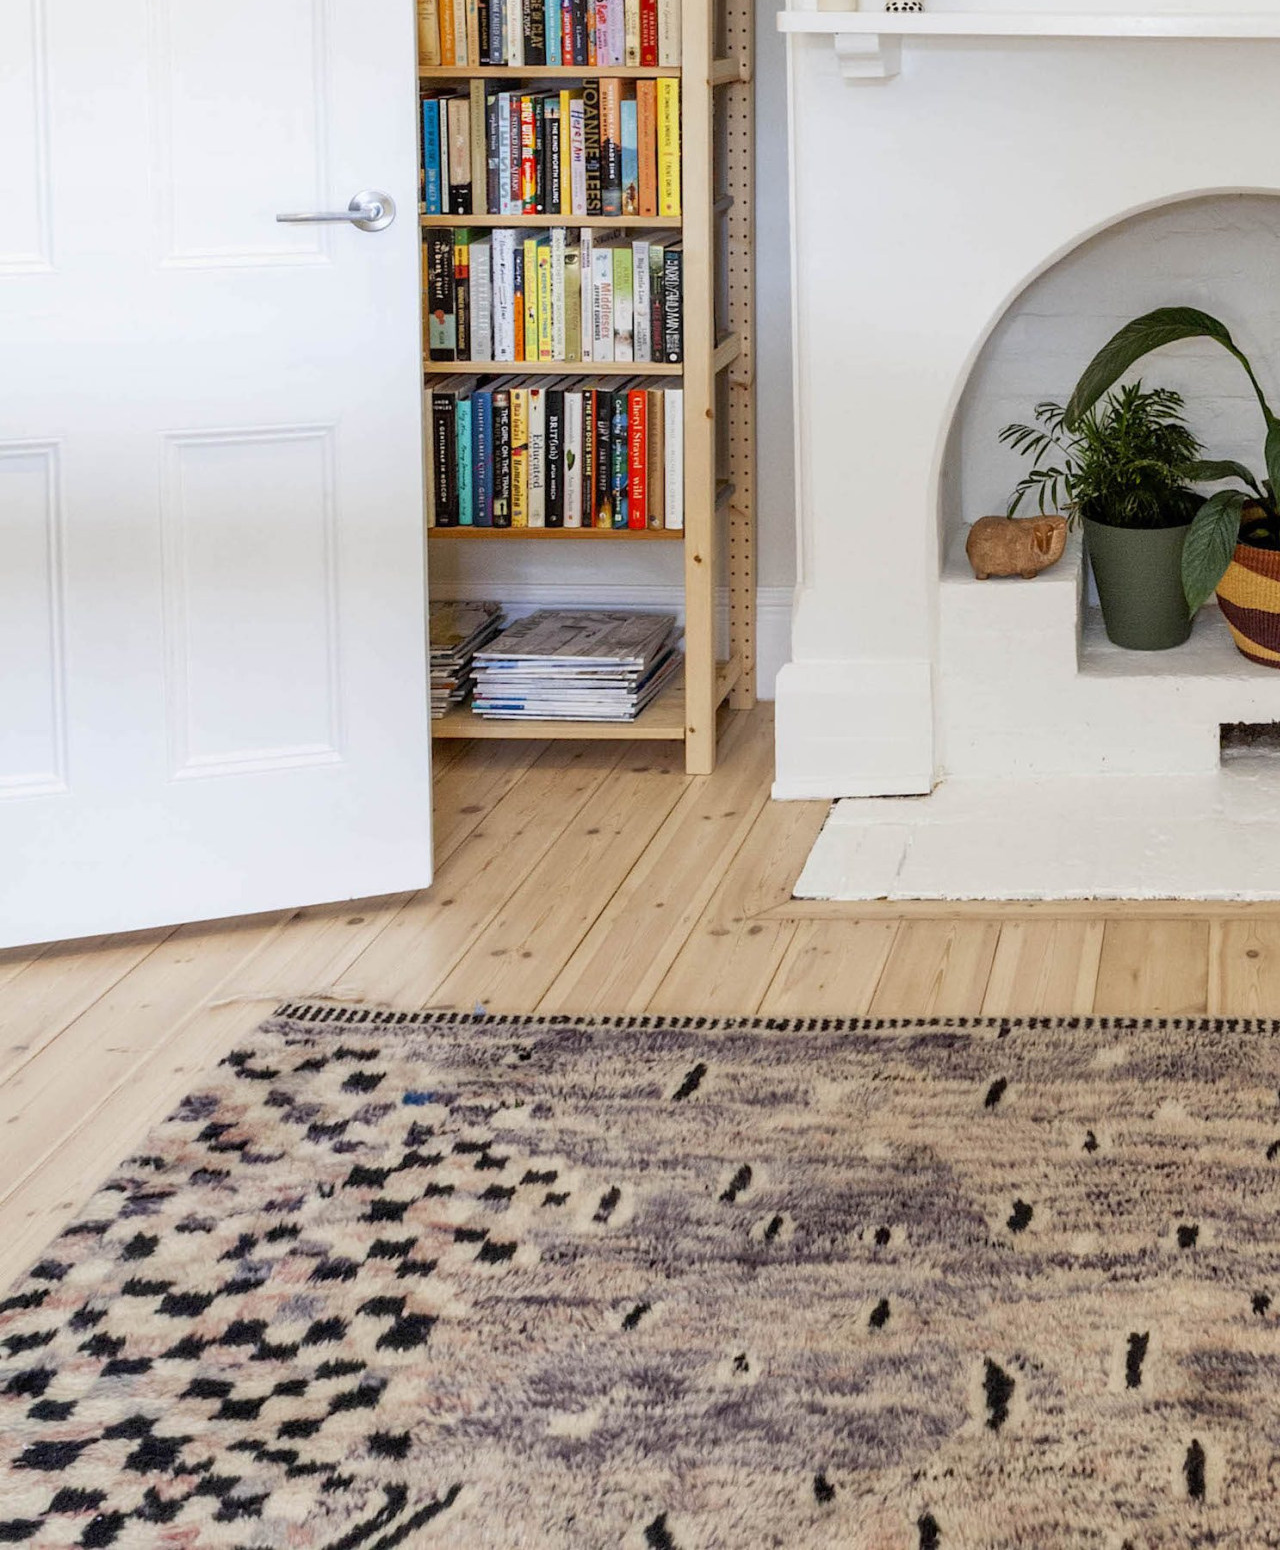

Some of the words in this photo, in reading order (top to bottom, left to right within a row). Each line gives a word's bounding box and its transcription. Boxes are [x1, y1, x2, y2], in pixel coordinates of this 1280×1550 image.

[531, 23, 543, 49] CLAY
[521, 101, 533, 123] STAY
[571, 110, 584, 137] Here
[582, 77, 600, 158] JOANNE
[522, 124, 533, 145] WITH
[586, 172, 600, 210] LEES
[593, 284, 601, 308] JEFFREY
[601, 282, 611, 339] Middlesex
[630, 397, 642, 429] Cheryl
[501, 426, 509, 444] GIRL
[597, 420, 609, 441] DRY
[502, 446, 509, 457] ON
[532, 434, 543, 489] Educated
[630, 432, 642, 468] Strayed
[513, 459, 523, 507] Homegoing
[614, 473, 622, 512] Everywhere
[633, 477, 643, 499] wild
